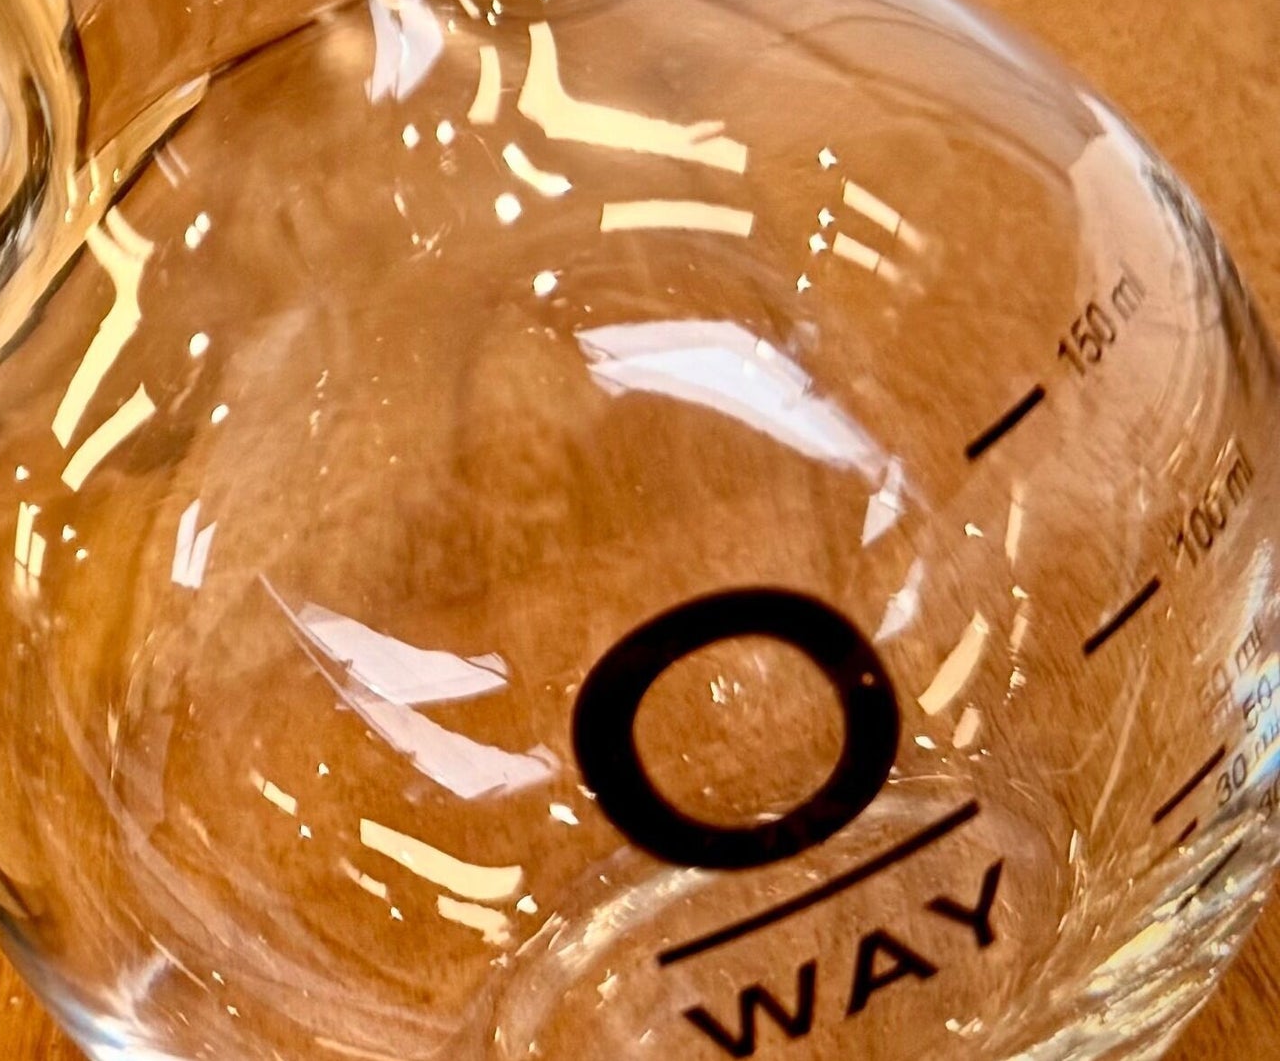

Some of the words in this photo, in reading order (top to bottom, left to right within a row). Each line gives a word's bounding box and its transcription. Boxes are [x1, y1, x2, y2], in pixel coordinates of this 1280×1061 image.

[1056, 301, 1117, 376] 150
[1111, 260, 1146, 322] ml
[1172, 492, 1228, 568] 100
[1226, 438, 1255, 506] ml
[572, 586, 901, 869] O
[1216, 753, 1247, 808] 30
[684, 858, 1006, 1060] WAY
